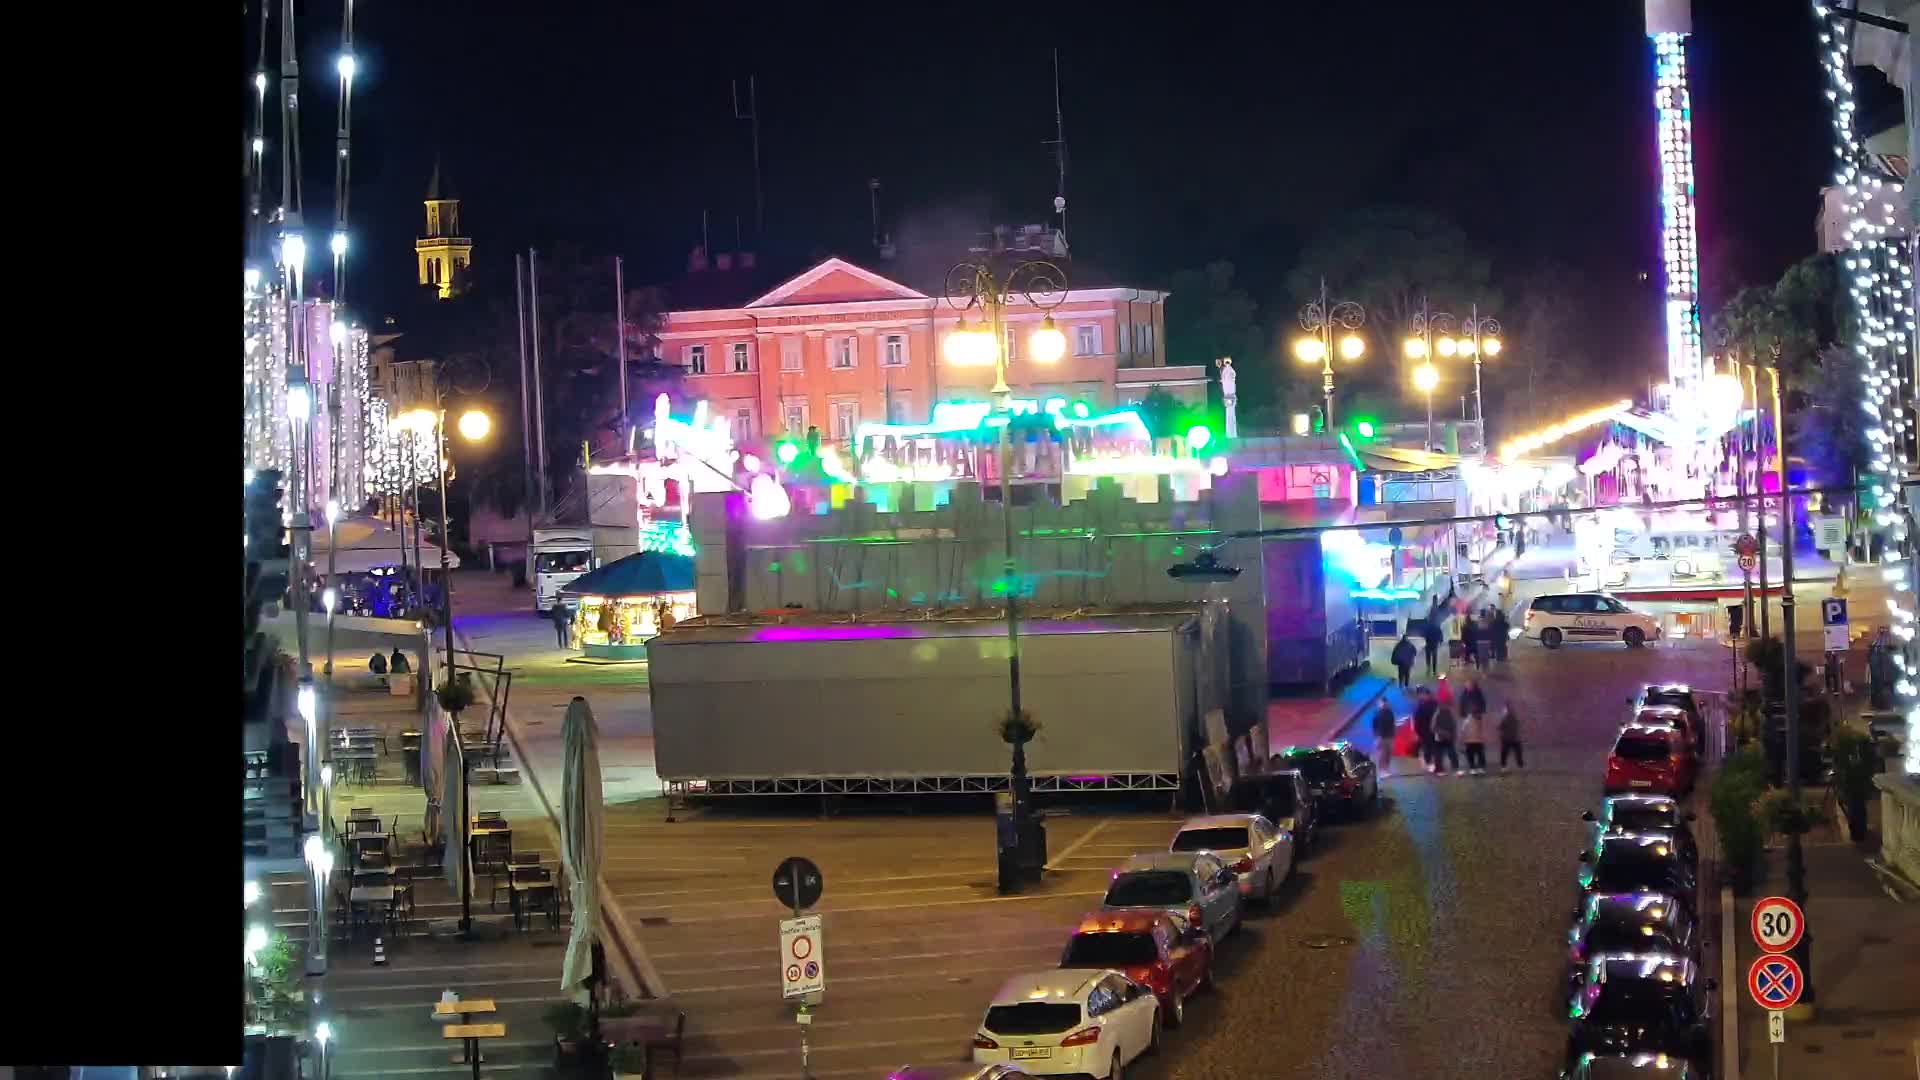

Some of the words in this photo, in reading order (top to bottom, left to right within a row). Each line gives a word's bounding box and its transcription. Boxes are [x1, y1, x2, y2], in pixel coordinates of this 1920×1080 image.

[1742, 558, 1753, 567] 20
[1827, 602, 1841, 621] P
[1762, 912, 1791, 937] 30
